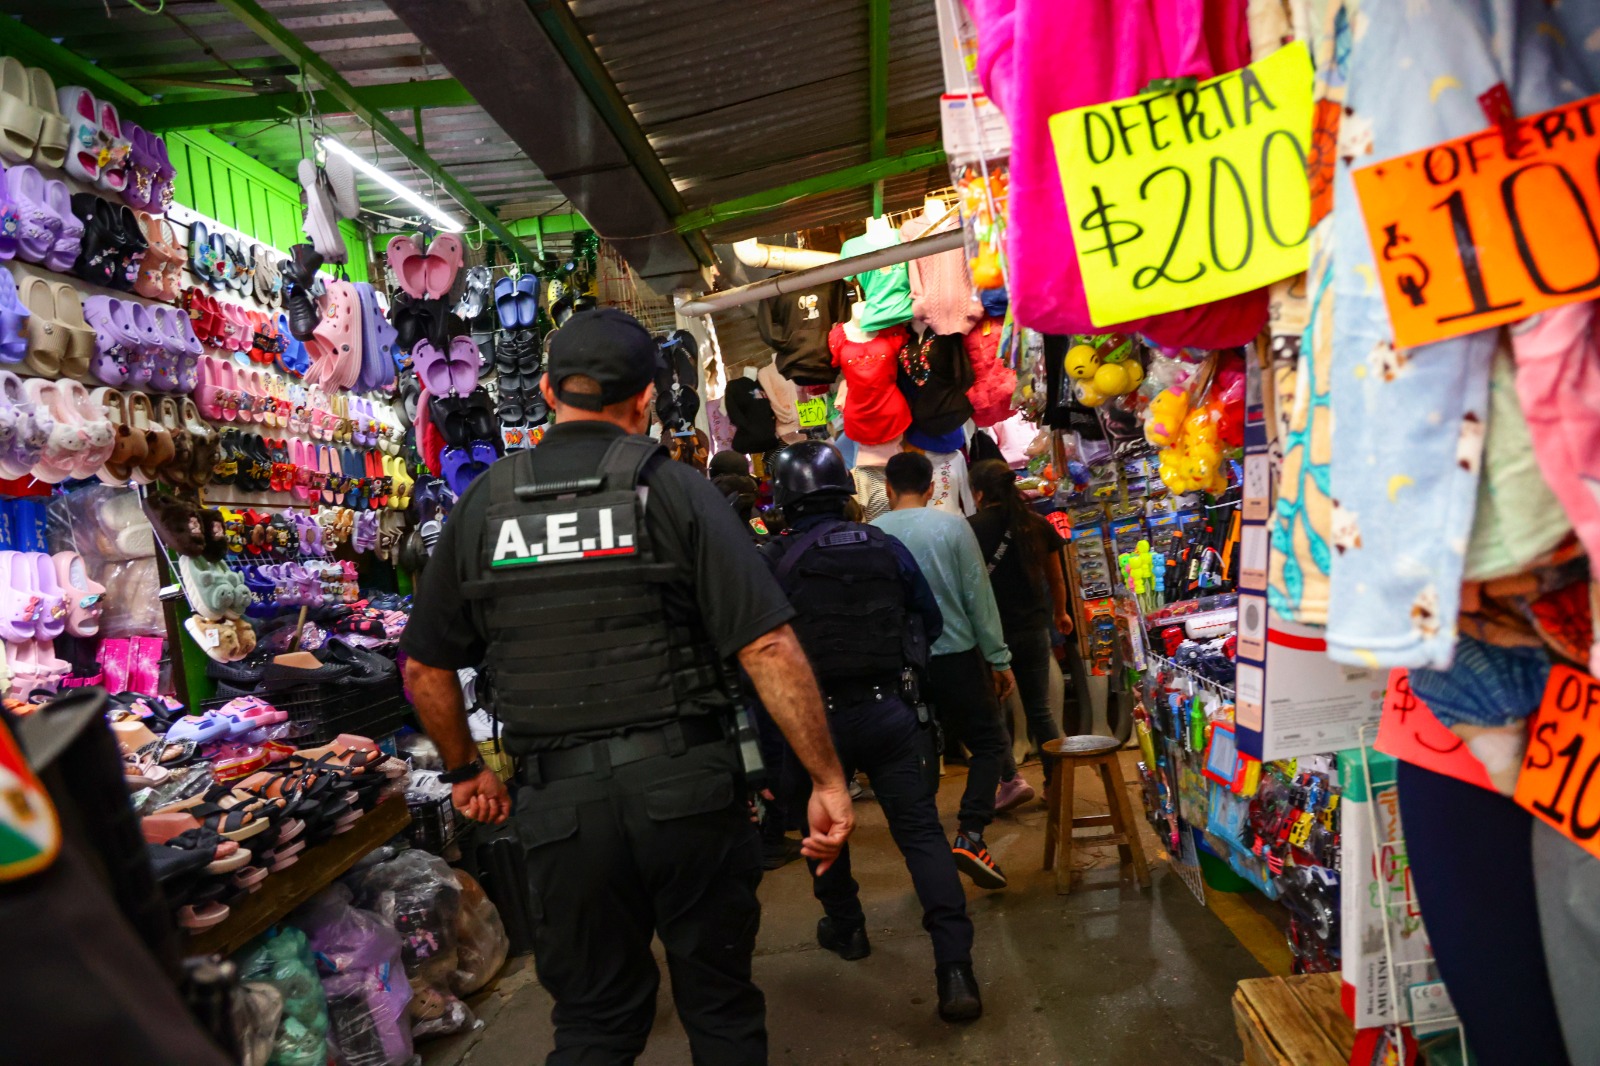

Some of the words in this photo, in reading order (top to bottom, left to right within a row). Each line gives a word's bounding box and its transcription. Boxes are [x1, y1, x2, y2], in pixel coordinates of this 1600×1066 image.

[1083, 66, 1277, 165] OFERTA
[1080, 129, 1310, 290] $200
[1382, 150, 1600, 325] $10
[493, 508, 633, 561] A.E.I.
